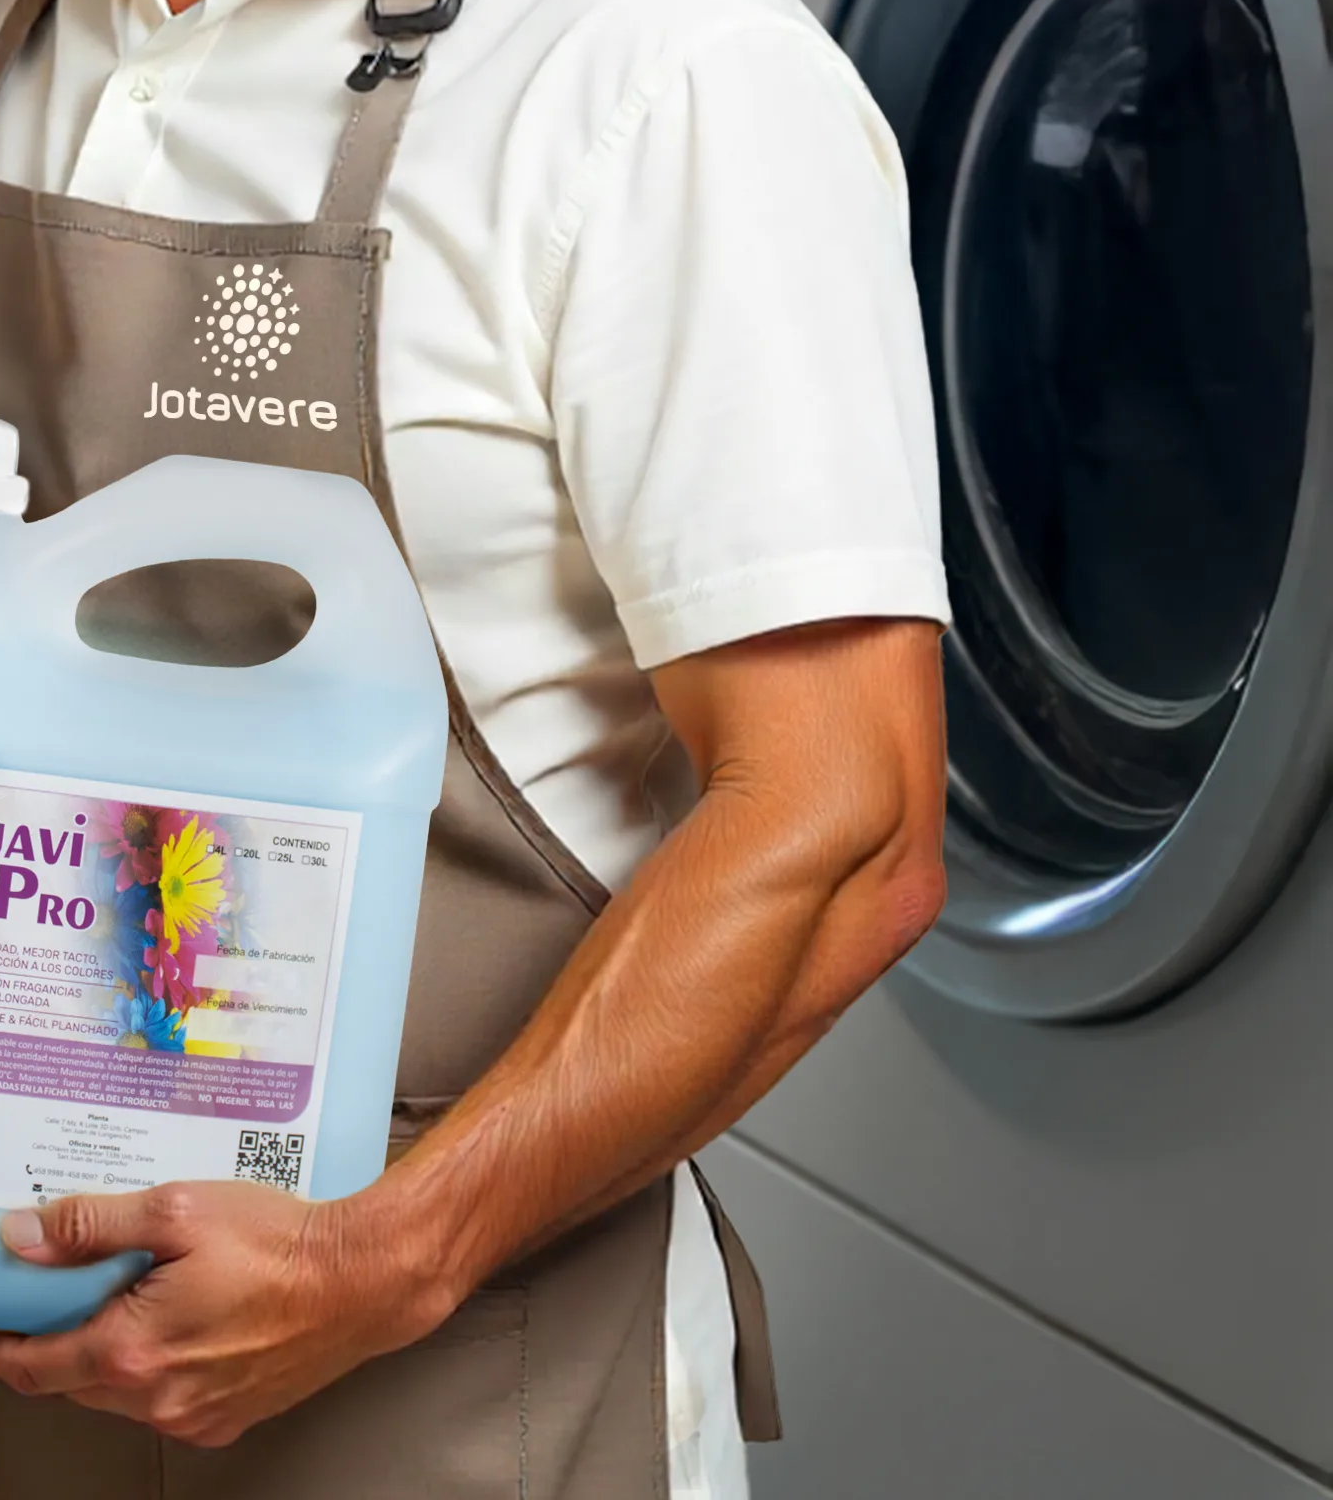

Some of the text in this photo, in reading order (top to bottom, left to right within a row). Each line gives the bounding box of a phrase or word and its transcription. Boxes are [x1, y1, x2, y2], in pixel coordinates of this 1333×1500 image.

[143, 382, 339, 432] Jotavere
[272, 835, 330, 852] CONTENIDO
[216, 844, 328, 867] 4L 20L 25L 30L
[22, 944, 59, 962] MEJOR
[61, 949, 99, 966] TACTO,
[9, 1012, 16, 1024] &
[18, 1011, 48, 1029] FÁCIL
[51, 1017, 119, 1038] PLANCHADO
